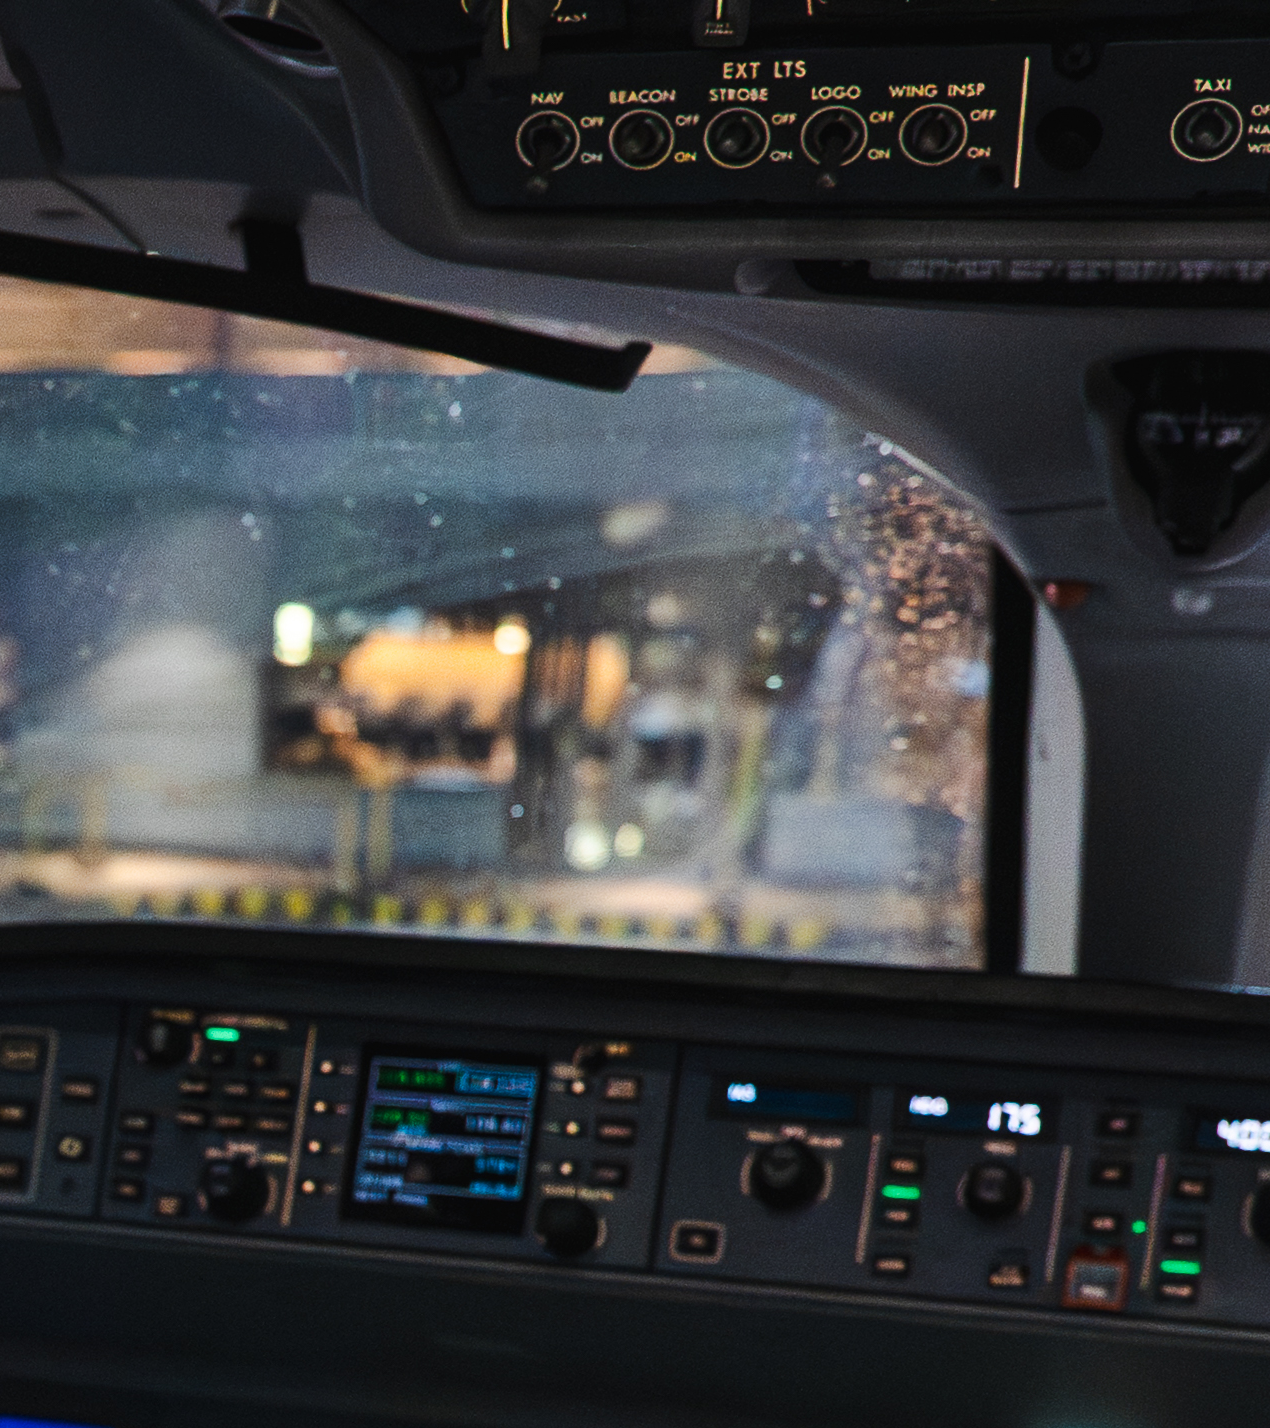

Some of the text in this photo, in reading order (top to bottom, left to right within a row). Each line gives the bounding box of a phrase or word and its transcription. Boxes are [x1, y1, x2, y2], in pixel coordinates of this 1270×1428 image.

[722, 59, 807, 80] EXT LTS
[888, 82, 986, 98] WING INSP
[1193, 78, 1232, 93] TAXI
[530, 91, 564, 105] NAV
[608, 89, 677, 105] BEACON
[709, 88, 769, 102] STROBE
[811, 85, 862, 101] LOGO
[580, 116, 605, 129] OFF
[674, 114, 701, 127] OFF
[771, 112, 798, 126] OFF
[869, 111, 895, 124] OFF
[969, 109, 997, 122] OFF
[580, 152, 603, 164] ON
[673, 150, 697, 163] ON
[769, 149, 794, 162] ON
[867, 147, 891, 161] ON
[967, 146, 992, 159] ON
